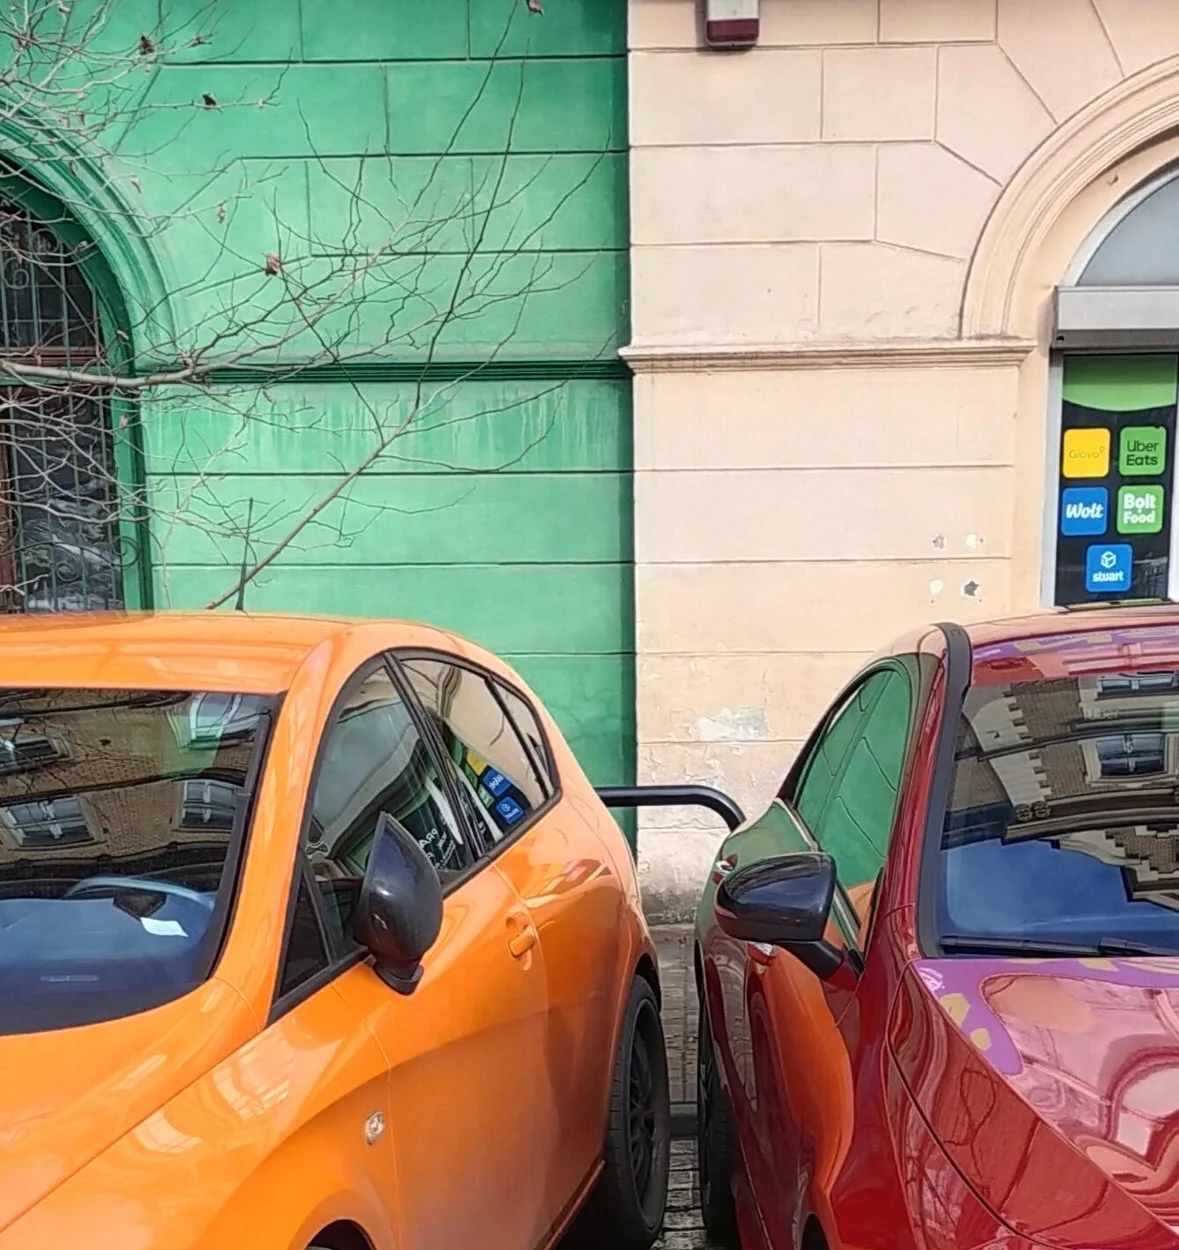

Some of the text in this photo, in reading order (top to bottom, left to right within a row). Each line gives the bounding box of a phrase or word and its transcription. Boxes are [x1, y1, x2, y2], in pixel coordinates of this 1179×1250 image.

[1126, 440, 1159, 453] Uber
[1126, 454, 1158, 466] Eats
[1123, 493, 1157, 509] Bolt
[1066, 503, 1105, 519] Wolt
[1123, 511, 1156, 525] Food
[1092, 570, 1124, 582] stuart
